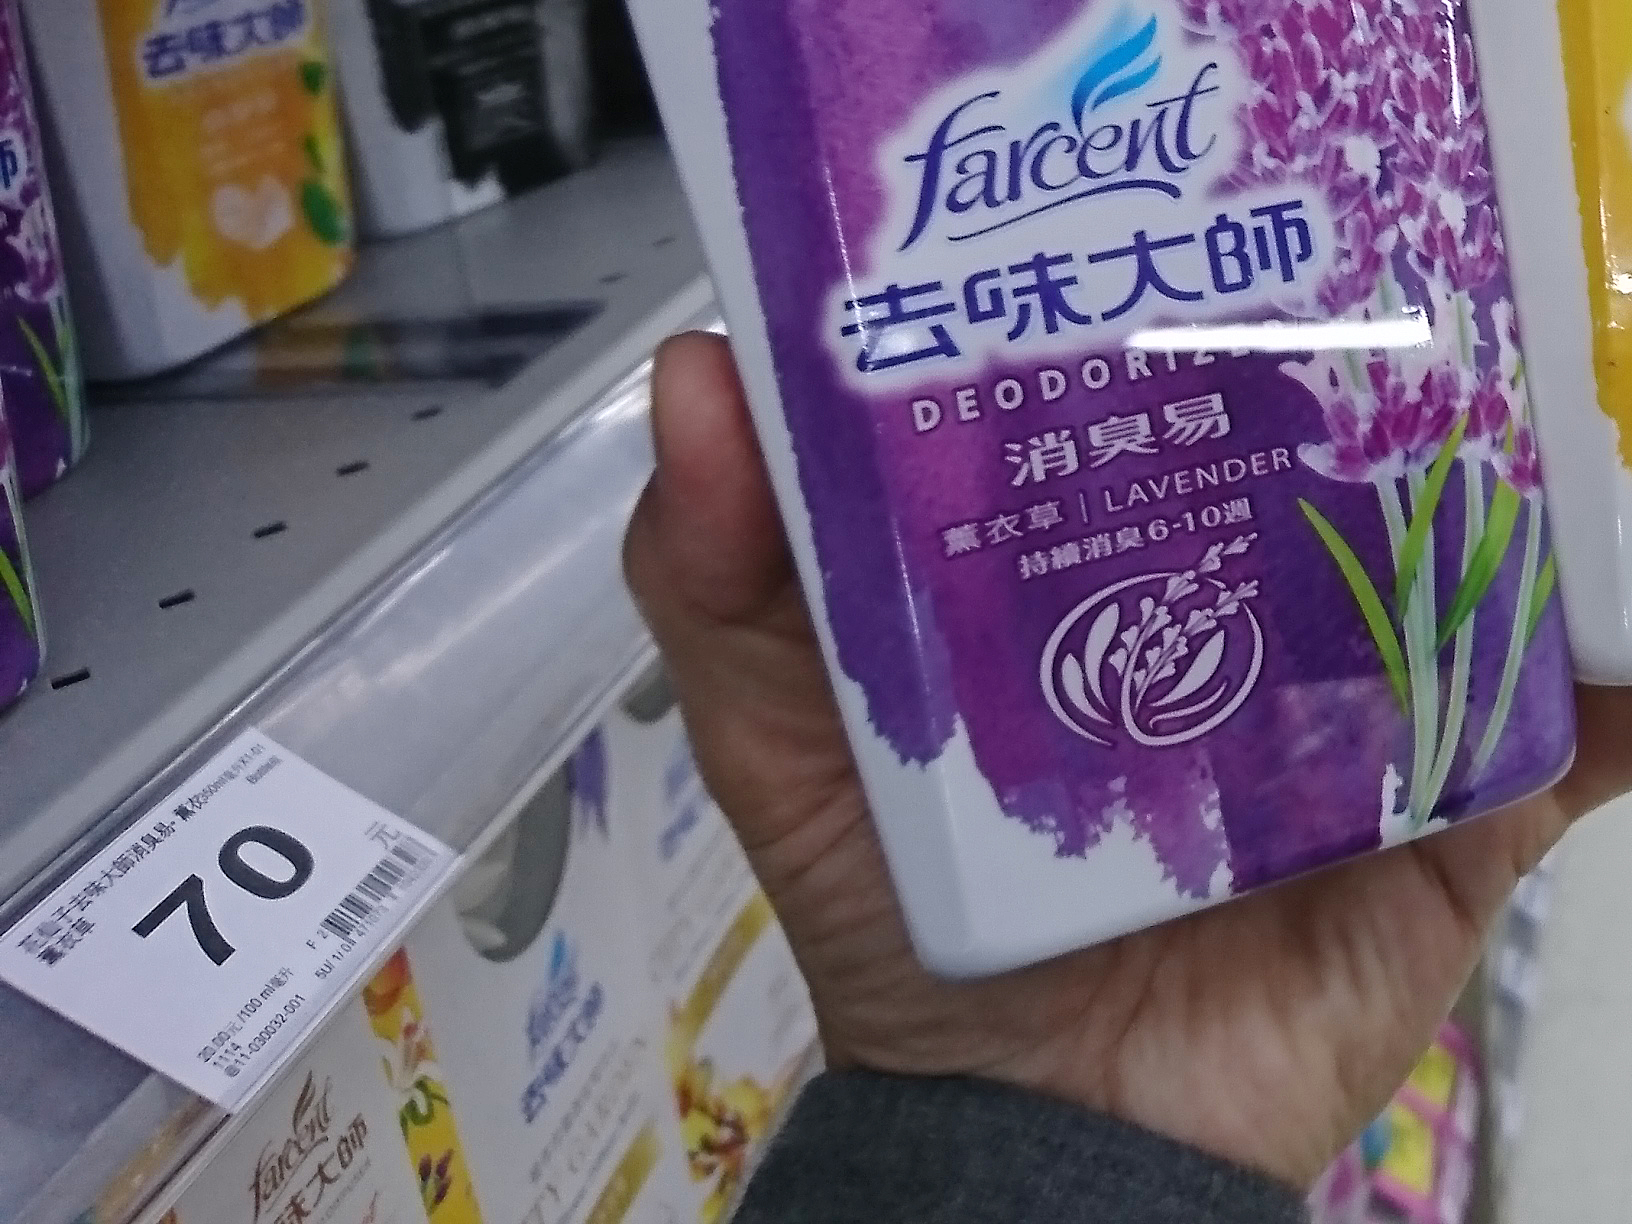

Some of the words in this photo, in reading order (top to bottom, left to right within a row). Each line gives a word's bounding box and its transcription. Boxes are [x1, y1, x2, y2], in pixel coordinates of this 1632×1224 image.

[896, 61, 1221, 253] farcent
[841, 199, 1316, 374] 去味大師
[1003, 392, 1232, 488] 消臭易
[1103, 446, 1293, 514] LAVENDER
[365, 821, 401, 850] 元
[131, 825, 315, 967] 70
